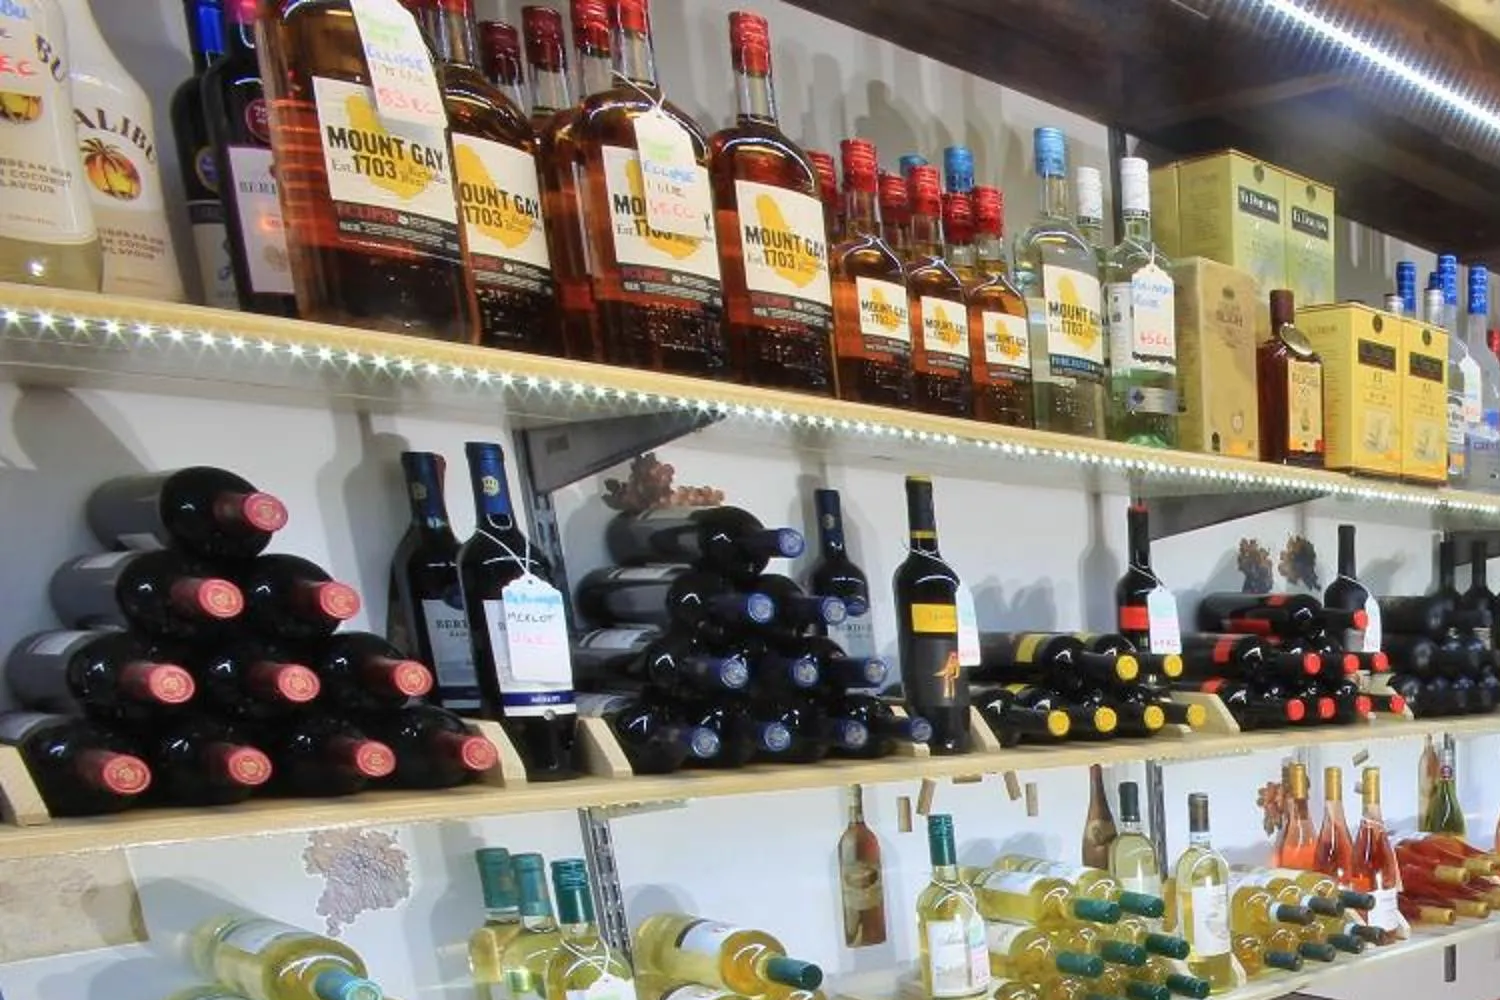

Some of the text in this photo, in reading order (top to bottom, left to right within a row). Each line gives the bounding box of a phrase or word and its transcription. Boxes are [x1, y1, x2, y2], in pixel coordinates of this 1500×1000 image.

[326, 125, 444, 171] MOUNT GAY
[352, 154, 397, 180] 1703
[460, 181, 512, 211] OUNT
[463, 204, 502, 230] 1703
[744, 225, 803, 252] MOUNT
[762, 247, 796, 271] 1703
[1048, 300, 1088, 326] MOUNT
